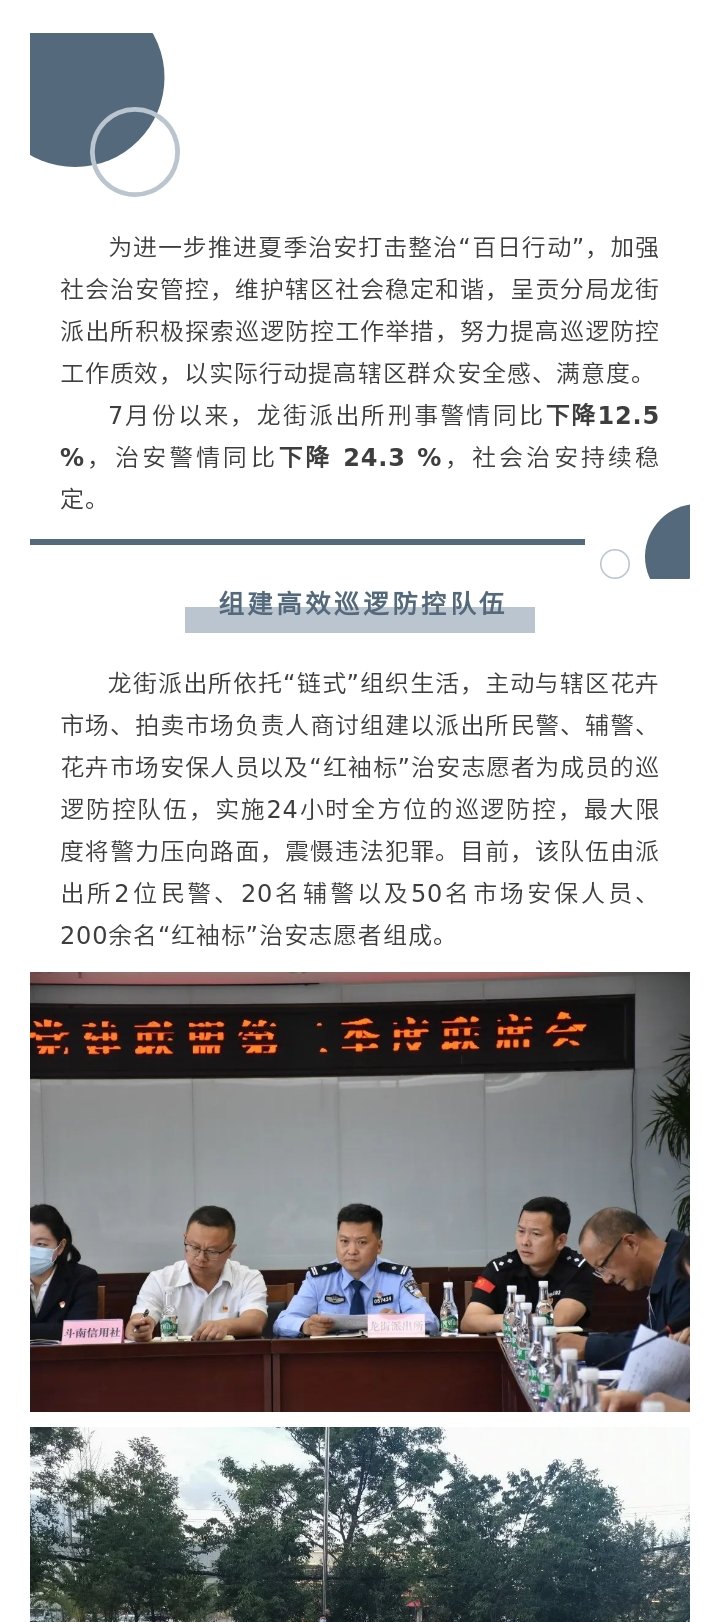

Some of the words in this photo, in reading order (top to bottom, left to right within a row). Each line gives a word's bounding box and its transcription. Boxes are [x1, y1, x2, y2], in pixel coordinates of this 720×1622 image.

[30, 1011, 587, 1055] 党建联盟第季度联席会
[64, 1327, 121, 1339] 斗南信用社
